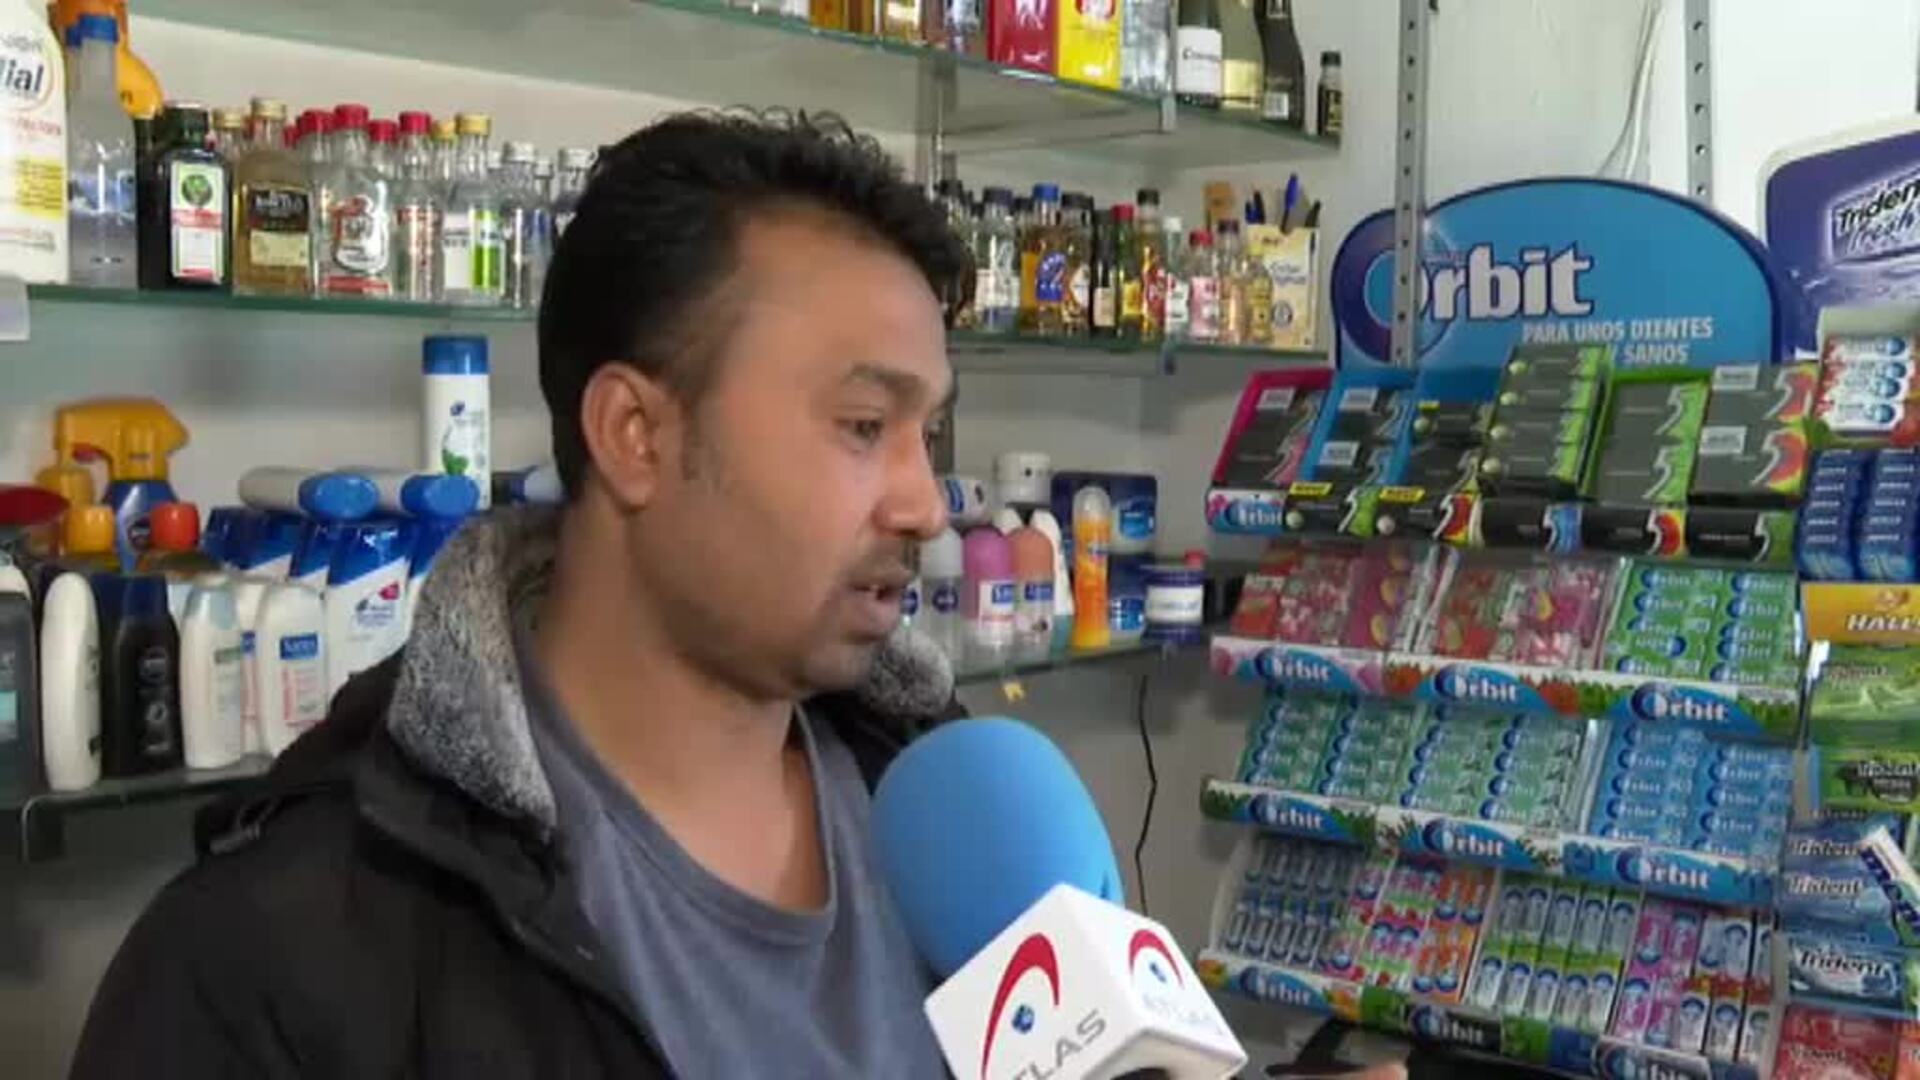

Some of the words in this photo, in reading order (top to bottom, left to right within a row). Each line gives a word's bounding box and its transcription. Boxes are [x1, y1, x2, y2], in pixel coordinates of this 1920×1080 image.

[0, 58, 45, 93] ial
[1834, 180, 1920, 230] Triden
[1523, 322, 1570, 344] PARA
[1574, 320, 1624, 343] UNOS
[1631, 316, 1713, 340] DIENTES
[1624, 343, 1689, 366] SANOS
[1254, 647, 1331, 682] Orbit
[1434, 664, 1517, 702] Orbit
[1631, 684, 1728, 721] Orbit
[1250, 794, 1322, 829] Orbit
[1422, 818, 1503, 858] Orbit
[1616, 847, 1709, 889] Orbit
[1800, 950, 1885, 977] Trident
[1239, 966, 1311, 1004] Orbit
[1012, 1007, 1107, 1080] TLAS
[1411, 1005, 1484, 1045] Orbit
